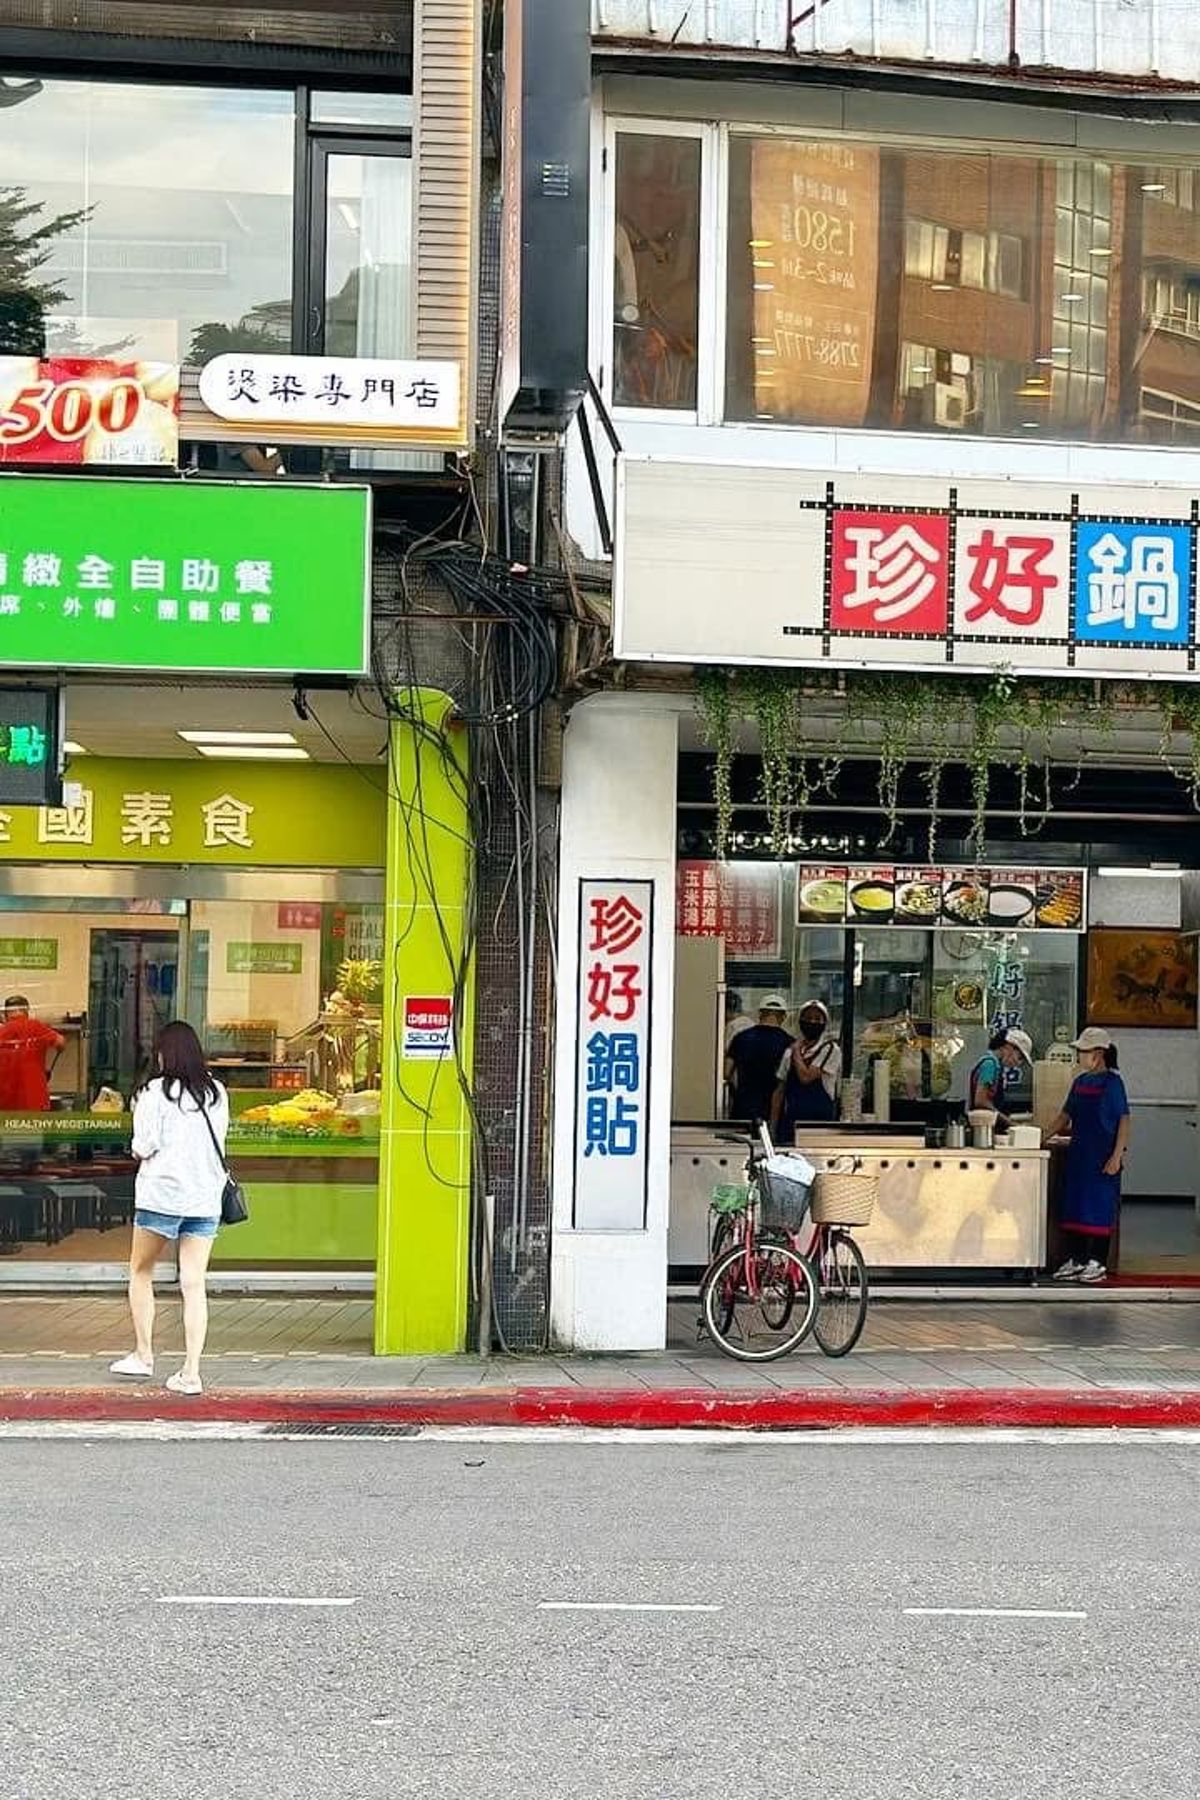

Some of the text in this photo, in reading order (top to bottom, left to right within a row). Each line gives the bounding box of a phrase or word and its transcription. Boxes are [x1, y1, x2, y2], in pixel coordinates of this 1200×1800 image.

[0, 380, 143, 440] 500
[0, 552, 272, 595] 緻全自助餐
[0, 726, 45, 765] 點
[0, 786, 254, 848] 國素食
[584, 895, 643, 1159] 珍好鍋貼
